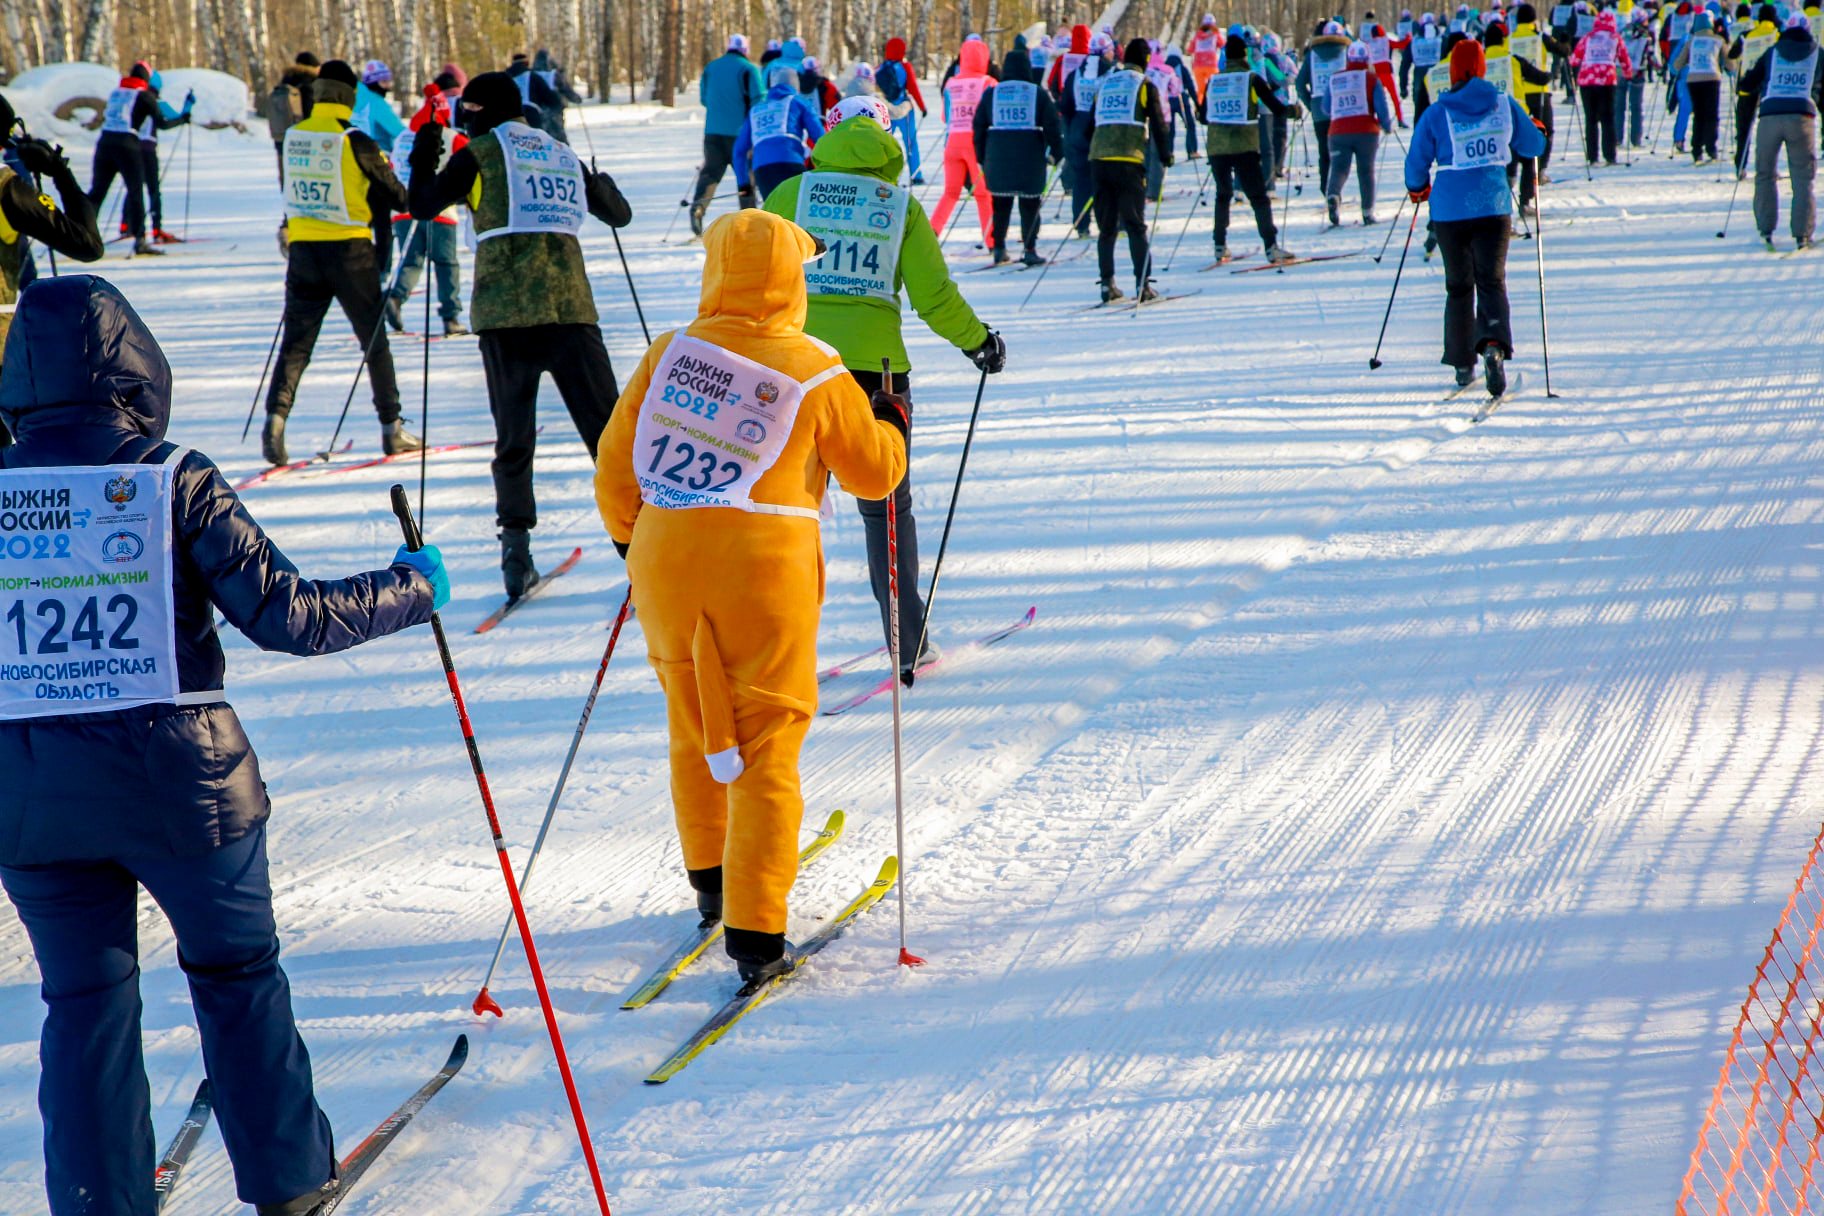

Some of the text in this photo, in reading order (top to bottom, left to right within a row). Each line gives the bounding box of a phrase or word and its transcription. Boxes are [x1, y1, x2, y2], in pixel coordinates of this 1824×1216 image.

[1466, 138, 1497, 158] 606
[292, 180, 331, 202] 1957
[526, 174, 578, 204] 1952
[810, 184, 858, 195] ЛЫЖНЯ
[810, 194, 856, 206] РОССИИ
[808, 205, 853, 220] 2022
[805, 274, 885, 291] ОВОСИБИРСКАЯ
[673, 355, 734, 387] ЛЫЖНЯ
[667, 368, 728, 402] РОССИИ
[660, 384, 719, 421] 2022
[652, 412, 760, 464] СПОРТ НОРМА ЖИЗНИ
[648, 434, 742, 492] 1232
[0, 488, 70, 509] ЫЖНЯ
[640, 476, 731, 506] ОВОСИБИРСКАЯ
[0, 510, 72, 531] ОССИИ
[0, 570, 149, 590] ПОРТ НОРМА ЖИЗНИ
[7, 594, 140, 655] 1242
[1, 657, 156, 680] НОВОСИБИРСКАЯ
[35, 682, 120, 700] ОБЛАСТЬ
